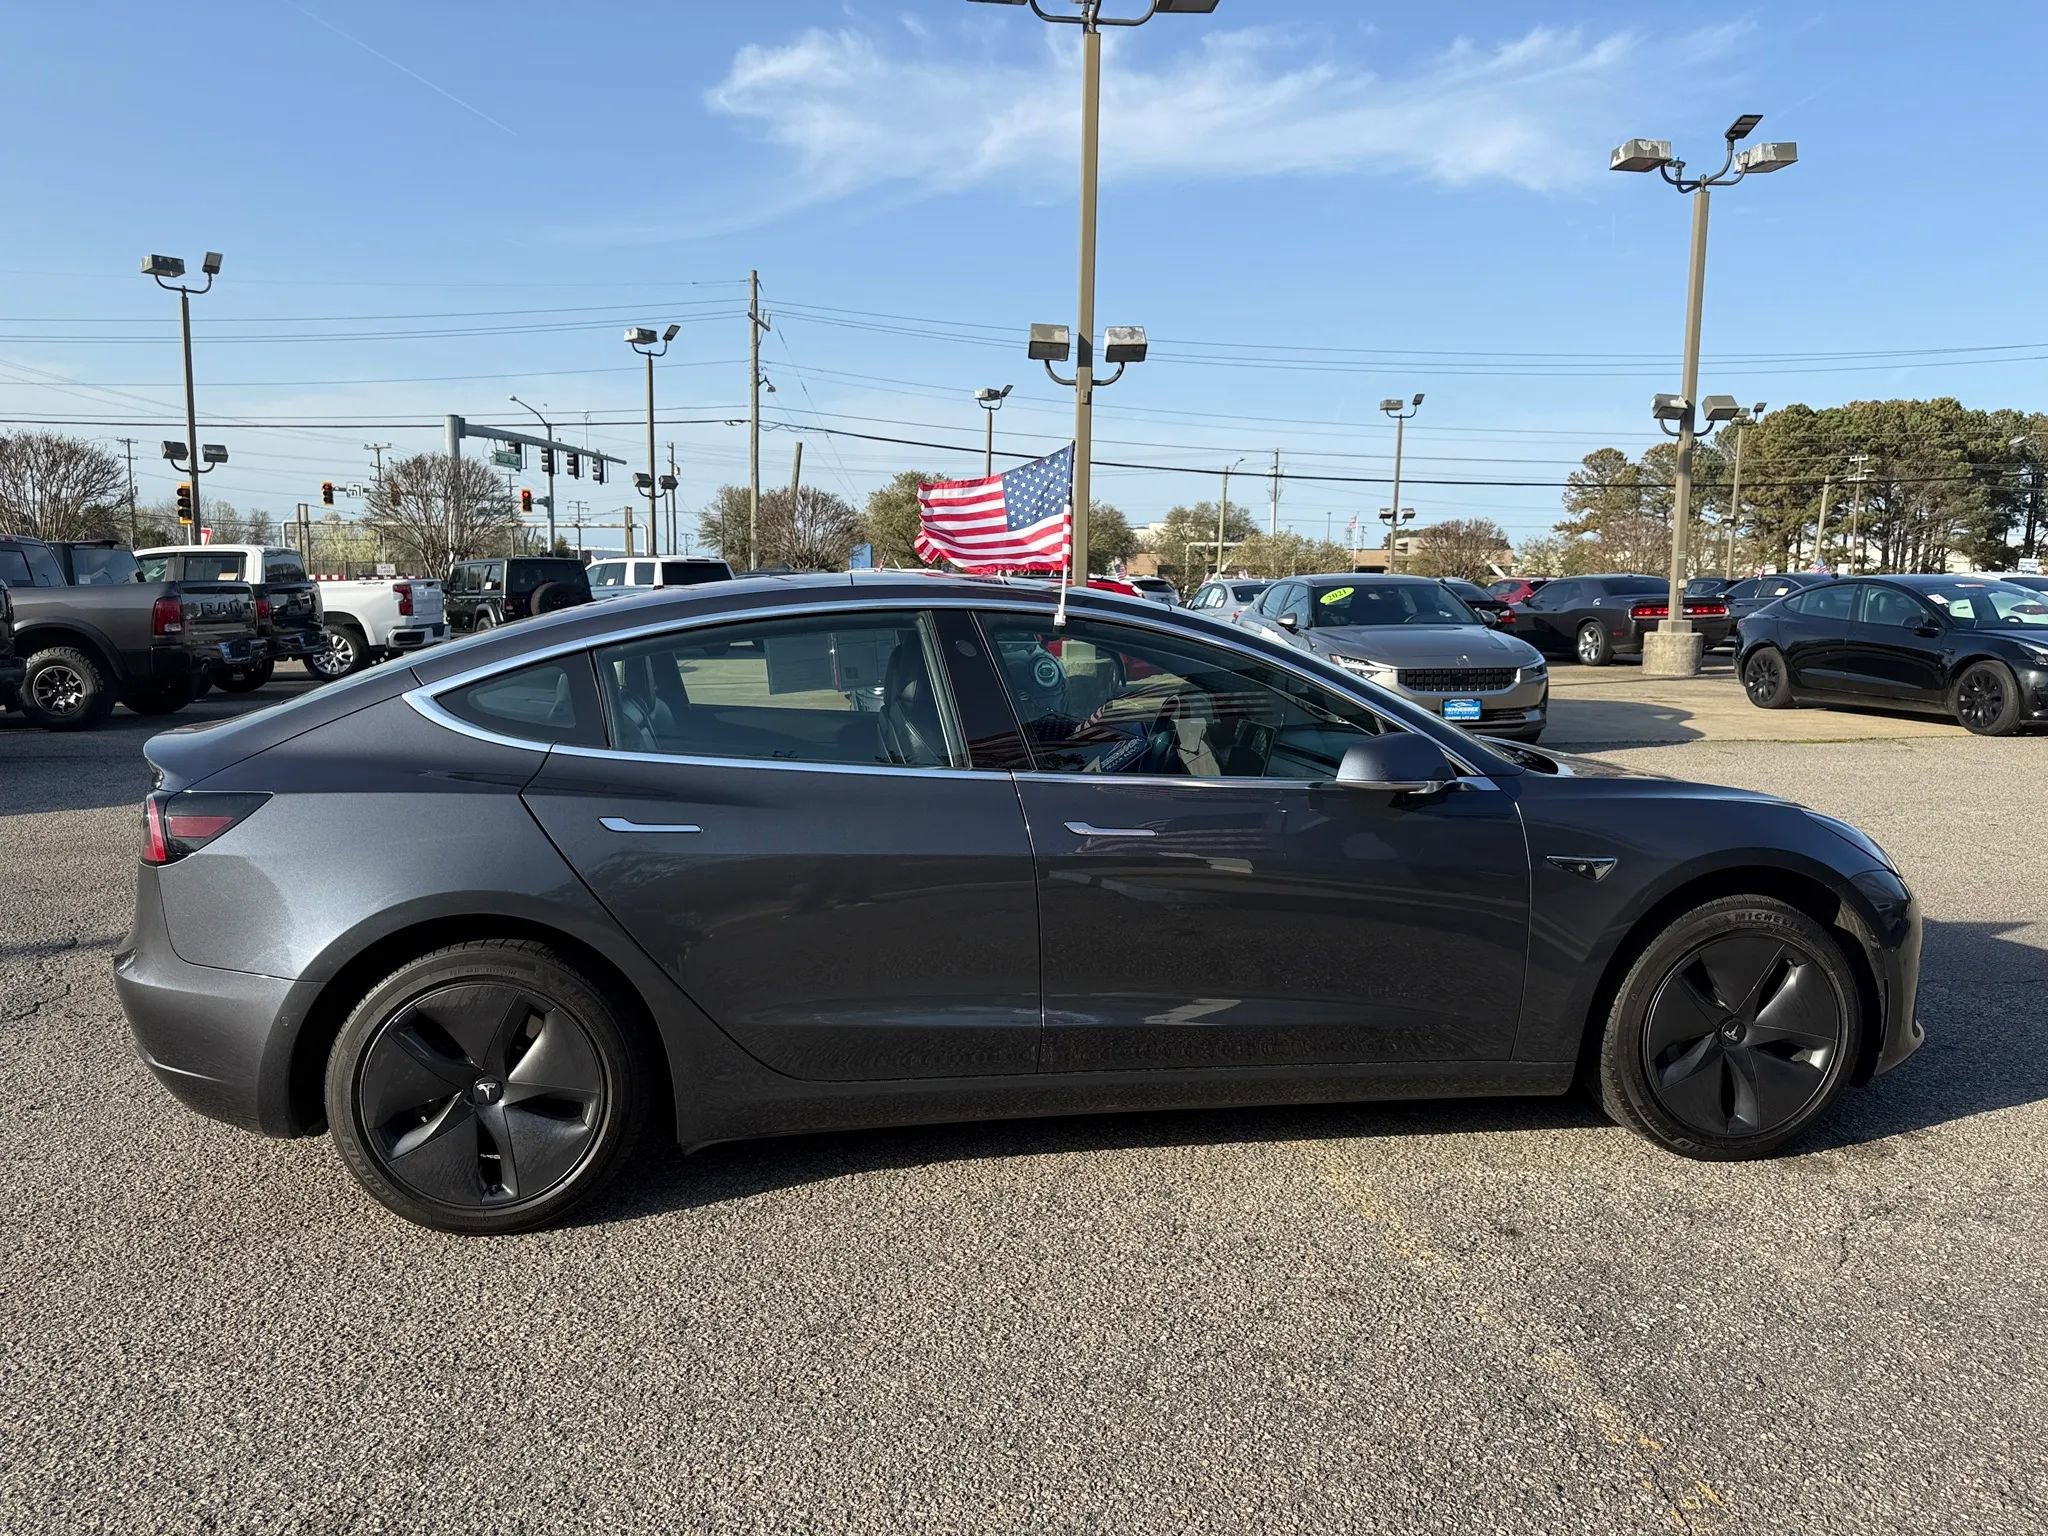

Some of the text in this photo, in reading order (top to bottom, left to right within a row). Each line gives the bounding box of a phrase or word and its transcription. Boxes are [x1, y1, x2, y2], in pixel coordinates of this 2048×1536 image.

[1326, 588, 1347, 600] 2021
[200, 601, 245, 615] RAM
[1734, 912, 1806, 932] MICHELIN
